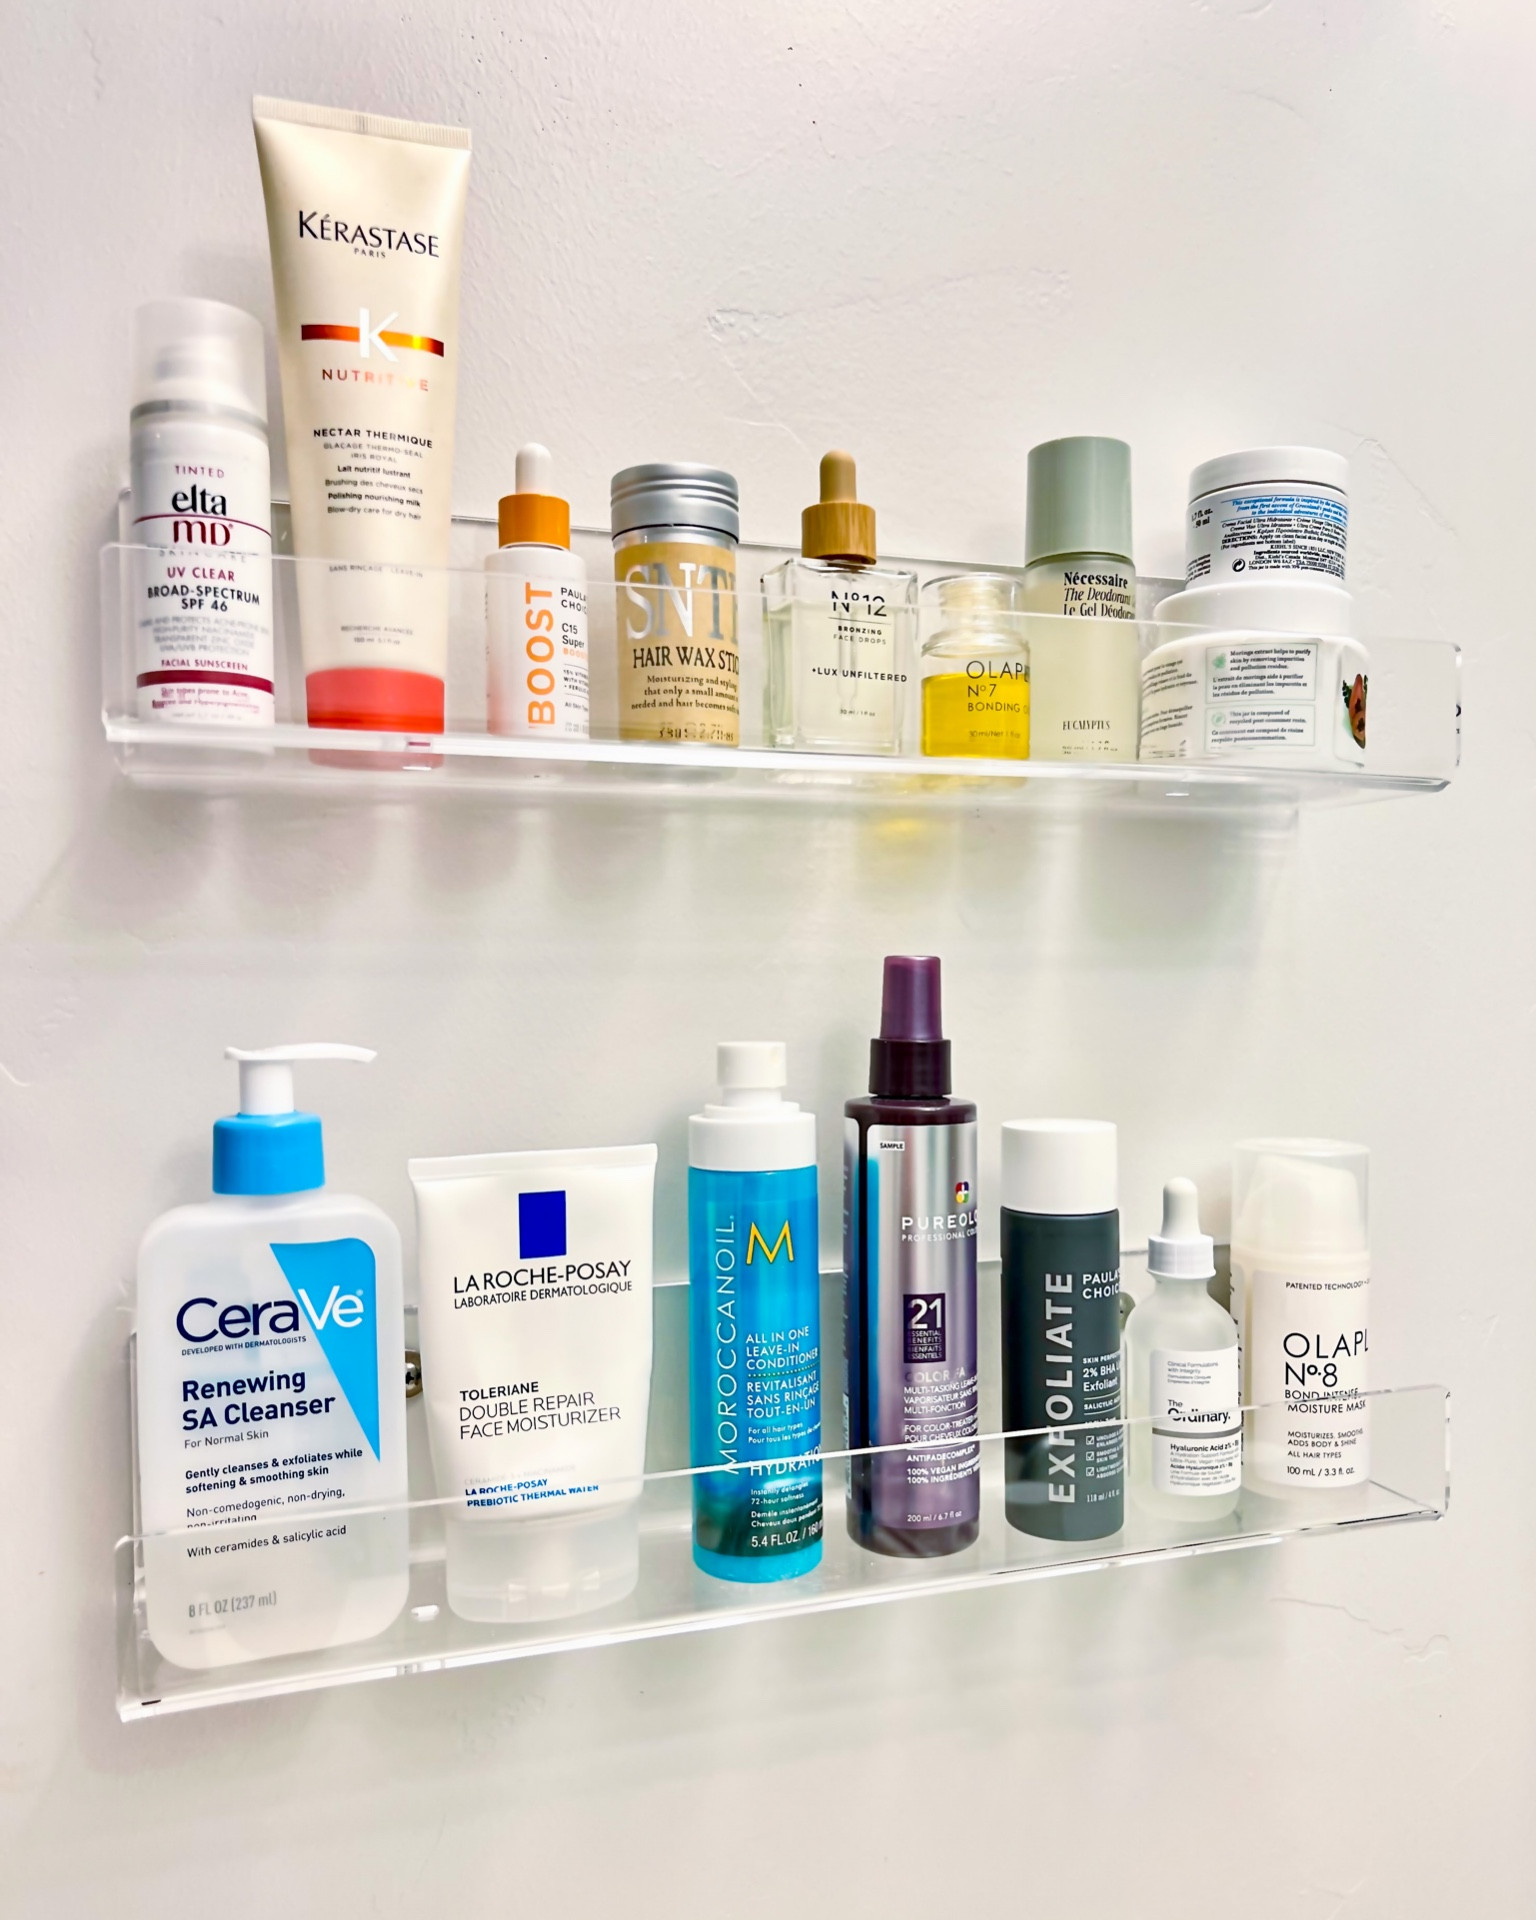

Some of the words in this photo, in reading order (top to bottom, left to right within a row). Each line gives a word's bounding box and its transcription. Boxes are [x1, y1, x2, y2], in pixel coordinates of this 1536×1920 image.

[299, 210, 439, 258] KÉRASTASE
[354, 248, 386, 258] PARIS
[359, 307, 399, 362] K
[313, 428, 361, 437] NECTAR
[366, 430, 433, 449] THERMIQUE
[175, 465, 224, 479] TINTED
[325, 479, 357, 488] Brushing
[172, 484, 226, 515] elta
[328, 492, 362, 502] Polishing
[365, 493, 404, 505] nourishing
[167, 567, 185, 578] UV
[192, 568, 235, 581] CLEAR
[1064, 572, 1128, 589] Nécessaire
[147, 585, 260, 605] BROAD-SPECTRUM
[1064, 587, 1084, 602] The
[1087, 588, 1130, 606] Deodorant
[181, 598, 204, 610] SPF
[211, 599, 228, 612] 46
[1080, 603, 1096, 617] Gel
[562, 623, 578, 635] C15
[838, 626, 882, 635] BRONZING
[562, 635, 584, 648] Super
[833, 634, 854, 642] FACE
[859, 637, 886, 645] DROPS
[525, 582, 555, 725] BOOST
[633, 646, 673, 669] HAIR
[676, 646, 715, 669] WAX
[161, 659, 190, 667] FACIAL
[195, 659, 248, 671] SUNSCREEN
[647, 675, 703, 686] Moisturizing
[842, 670, 907, 682] UNFILTERED
[644, 687, 661, 696] that
[663, 688, 683, 699] only
[692, 688, 713, 697] small
[631, 700, 656, 710] needed
[658, 700, 674, 708] and
[676, 699, 693, 708] hair
[695, 700, 725, 711] becomes
[968, 702, 1020, 713] BONDING
[880, 1142, 903, 1150] SAMPLE
[746, 1220, 794, 1265] M
[902, 1230, 965, 1242] PROFESSIONAL
[454, 1275, 480, 1294] LA
[484, 1260, 631, 1290] ROCHE-POSAY
[1286, 1281, 1322, 1290] PATENTED
[454, 1290, 527, 1309] LABORATOIRE
[530, 1281, 632, 1300] DERMATOLOGIQUE
[176, 1285, 364, 1343] CeraVe
[911, 1298, 942, 1330] 21
[746, 1333, 767, 1344] ALL
[771, 1331, 785, 1341] IN
[788, 1326, 809, 1338] ONE
[182, 1344, 223, 1356] DEVELOPED
[225, 1342, 243, 1350] WITH
[245, 1336, 306, 1349] DERMATOLOGISTS
[746, 1342, 799, 1357] LEAVE-IN
[746, 1347, 818, 1370] CONDITIONER
[1083, 1368, 1097, 1378] 2%
[1101, 1364, 1115, 1376] BHA
[182, 1370, 306, 1402] Renewing
[747, 1370, 817, 1393] REVITALISANT
[904, 1383, 960, 1394] MULTI-TASKING
[1083, 1377, 1118, 1392] Exfoliant
[460, 1381, 539, 1402] TOLERIANE
[747, 1393, 780, 1405] SANS
[784, 1385, 819, 1401] RINÇAGE
[904, 1392, 958, 1404] VAPORISATEUR
[460, 1399, 528, 1421] DOUBLE
[533, 1391, 595, 1412] REPAIR
[747, 1397, 816, 1419] TOUT-EN-UN
[904, 1401, 966, 1414] MULTI-FONCTION
[1084, 1400, 1113, 1410] SALICYLIC
[1168, 1399, 1182, 1407] The
[1287, 1403, 1343, 1414] MOISTURE
[1346, 1402, 1366, 1412] MASK
[182, 1407, 217, 1431] SA
[224, 1397, 336, 1425] Cleanser
[460, 1421, 503, 1439] FACE
[507, 1407, 621, 1434] MOISTURIZER
[749, 1426, 760, 1434] For
[772, 1424, 785, 1433] hair
[787, 1422, 803, 1432] types
[904, 1424, 921, 1433] FOR
[184, 1439, 201, 1448] For
[205, 1433, 244, 1446] Normal
[247, 1429, 269, 1440] Skin
[749, 1436, 764, 1444] Pour
[1287, 1439, 1308, 1447] ADDS
[1311, 1439, 1332, 1447] BODY
[1323, 1451, 1341, 1459] TYPES
[185, 1468, 220, 1480] Gently
[222, 1460, 268, 1475] cleanses
[282, 1453, 333, 1466] exfoliates
[335, 1448, 363, 1459] while
[930, 1464, 957, 1474] VEGAN
[1287, 1466, 1300, 1476] 100
[1303, 1467, 1315, 1476] mL
[1325, 1467, 1337, 1476] 3.3
[186, 1478, 236, 1494] softening
[250, 1468, 304, 1485] smoothing
[308, 1466, 329, 1476] skin
[187, 1496, 284, 1518] Non-comedogenic,
[288, 1489, 345, 1504] non-drying,
[467, 1495, 518, 1507] PREBIOTIC
[521, 1489, 566, 1502] THERMAL
[751, 1497, 779, 1505] 72-hour
[907, 1514, 921, 1522] 200
[187, 1546, 211, 1558] With
[214, 1537, 269, 1554] ceramides
[283, 1529, 323, 1544] salicylic
[326, 1525, 346, 1537] acid
[751, 1536, 768, 1548] 5.4
[189, 1604, 196, 1618] 8
[198, 1602, 211, 1616] FL
[214, 1599, 228, 1614] OZ
